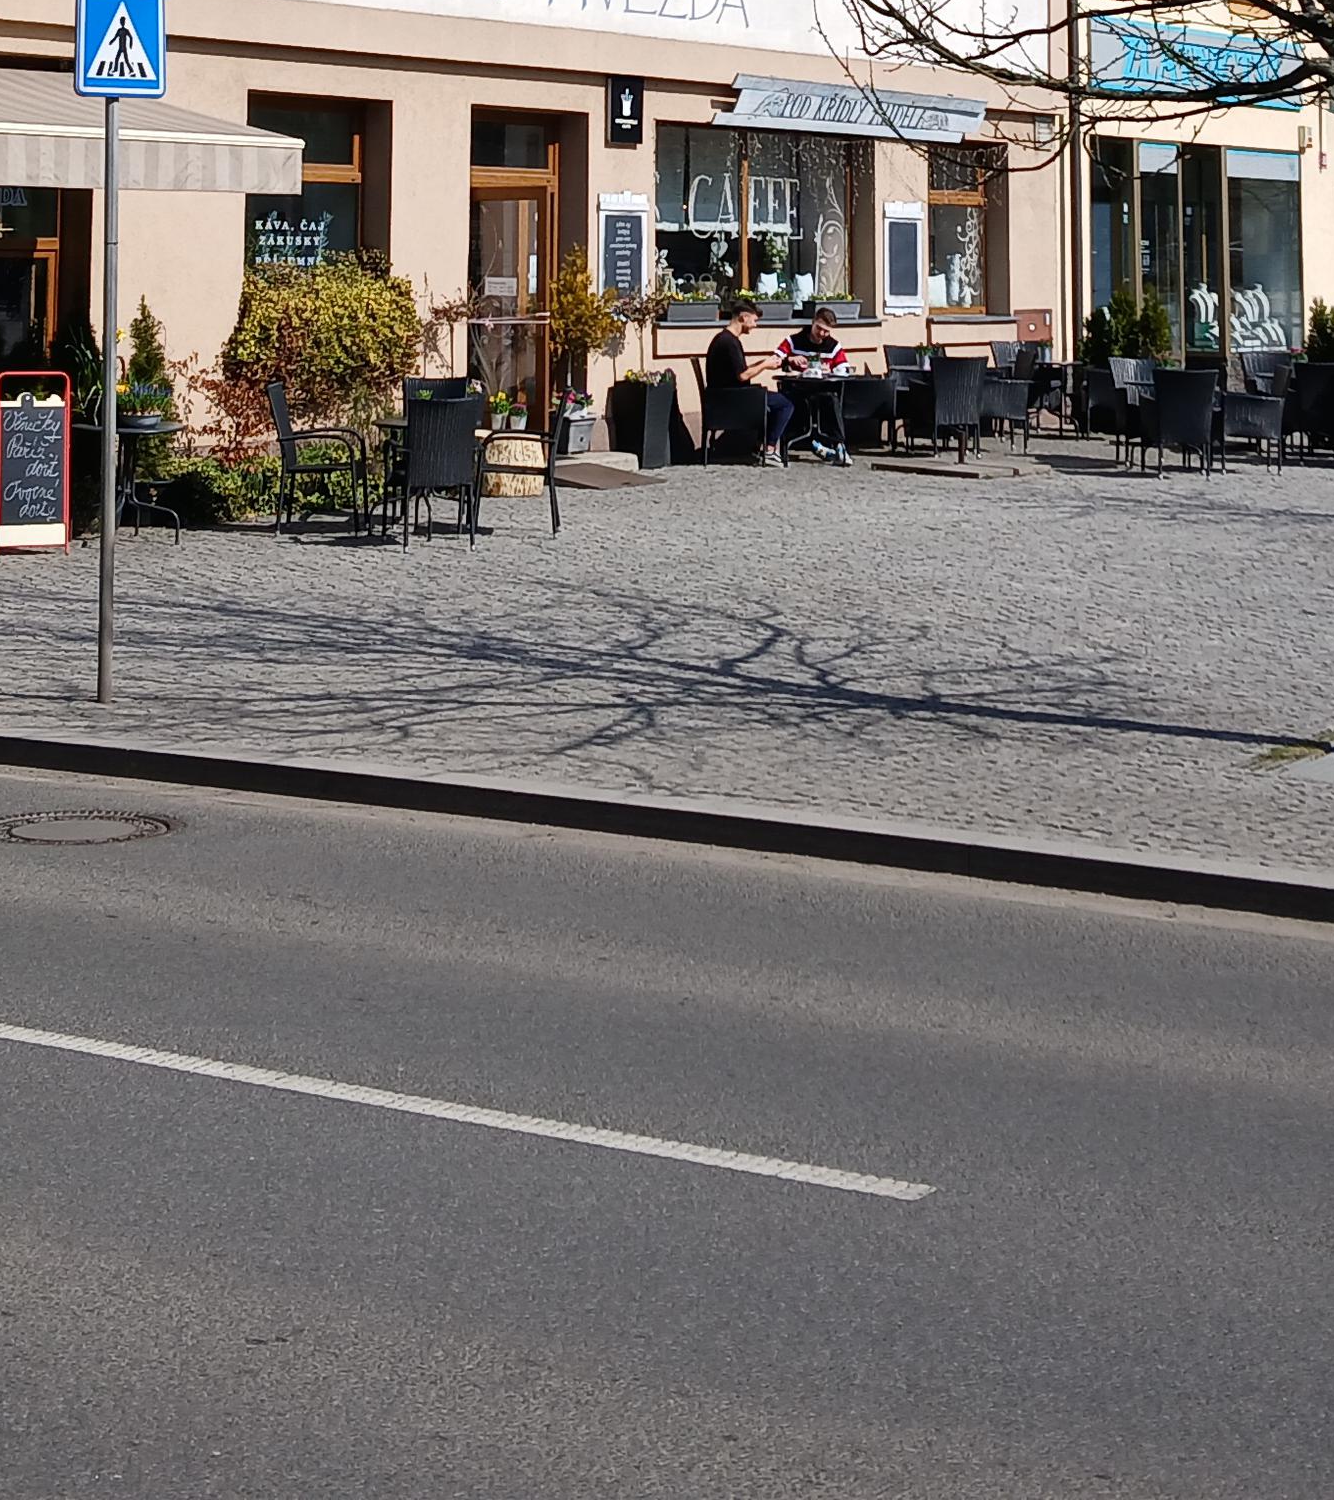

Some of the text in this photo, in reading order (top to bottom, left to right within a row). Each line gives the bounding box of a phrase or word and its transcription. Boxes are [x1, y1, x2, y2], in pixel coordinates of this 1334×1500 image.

[781, 93, 811, 119] POD
[299, 219, 325, 231] ČAJ
[258, 233, 321, 246] ZÁKUSKY
